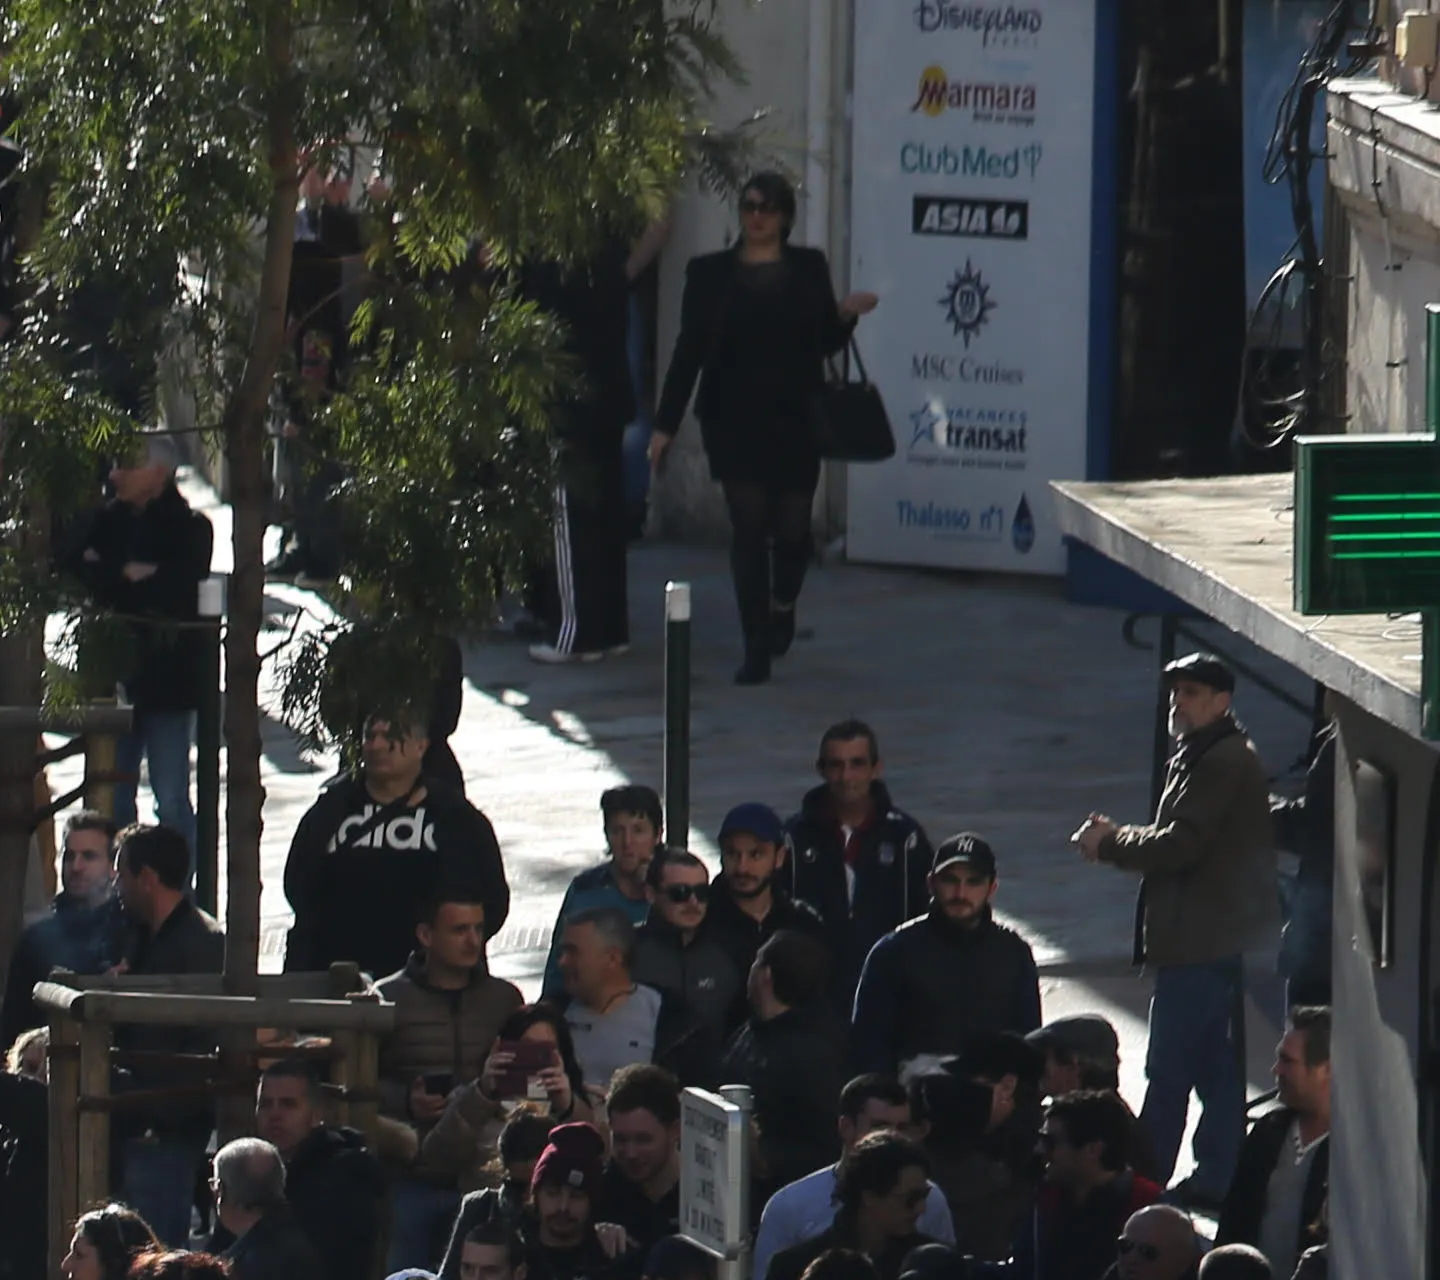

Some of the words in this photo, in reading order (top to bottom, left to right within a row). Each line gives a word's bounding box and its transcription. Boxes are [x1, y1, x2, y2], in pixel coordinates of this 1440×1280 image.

[911, 77, 1036, 112] Marmara
[919, 202, 987, 237] ASIA
[911, 353, 954, 381] MSC
[959, 357, 1024, 385] Cruises
[946, 423, 1027, 454] transat
[897, 500, 970, 531] Thalasso
